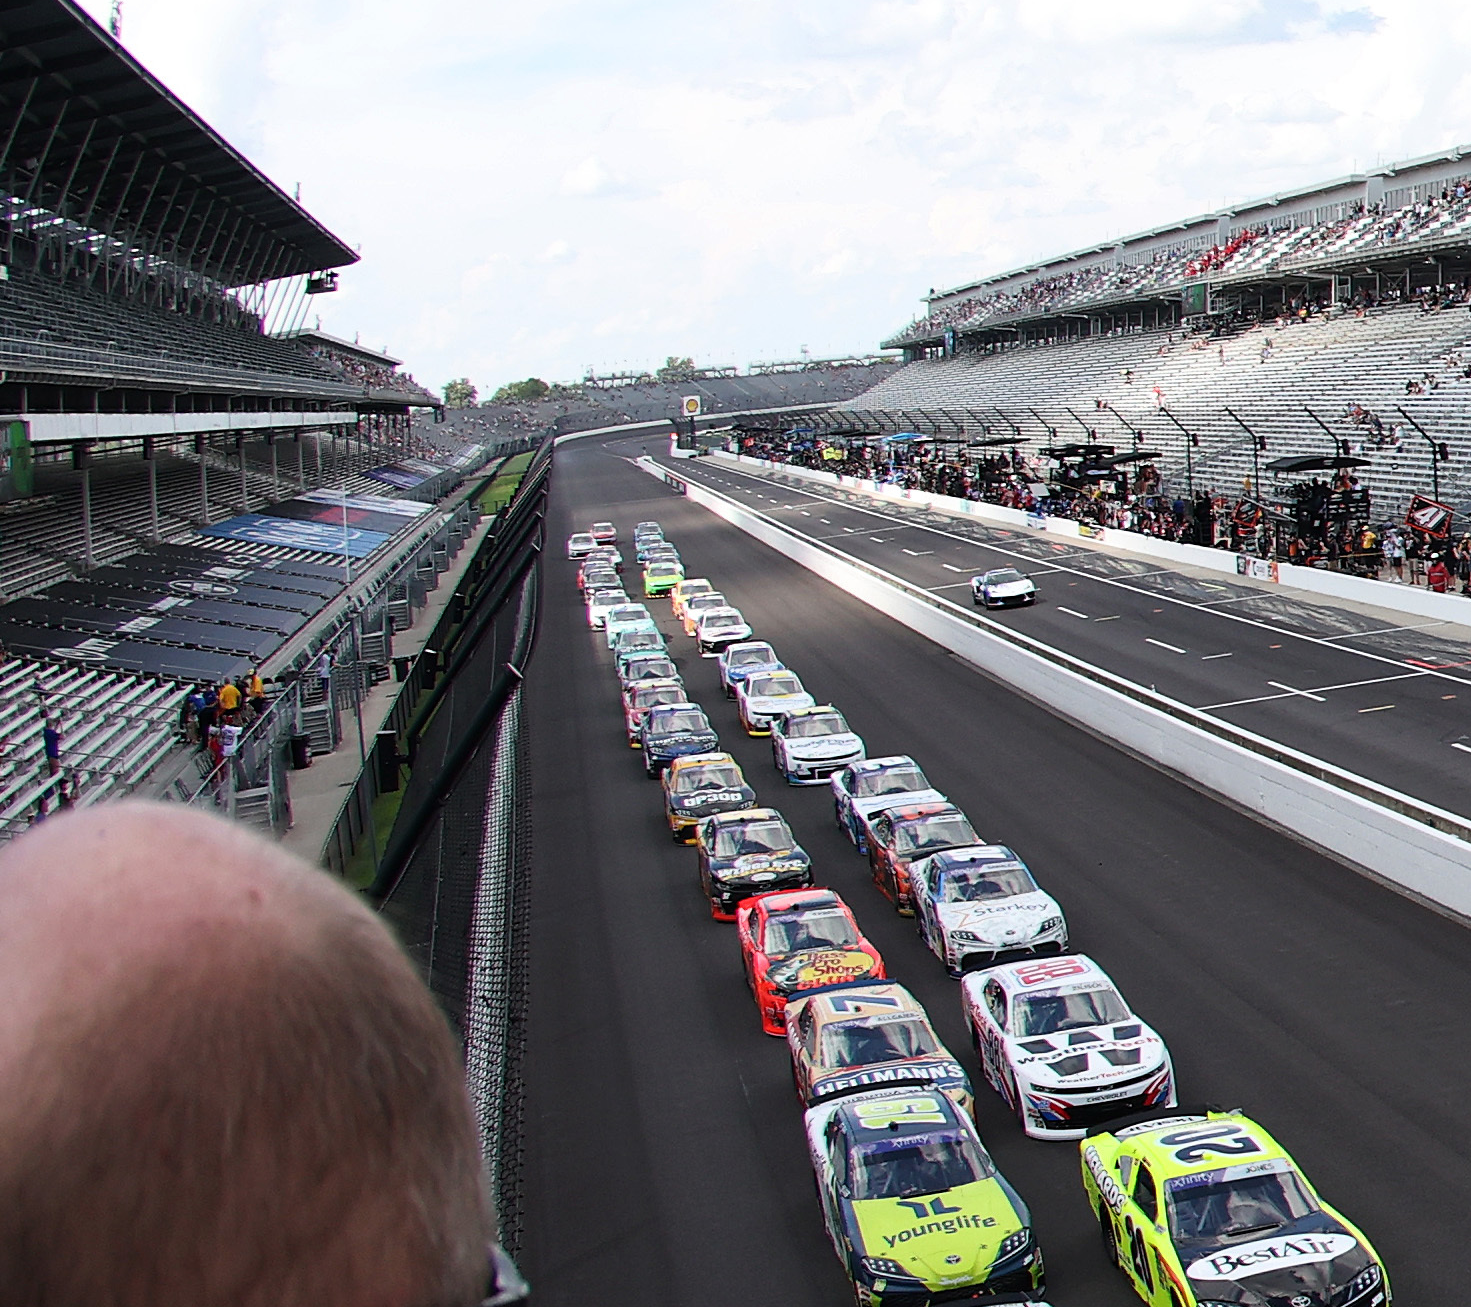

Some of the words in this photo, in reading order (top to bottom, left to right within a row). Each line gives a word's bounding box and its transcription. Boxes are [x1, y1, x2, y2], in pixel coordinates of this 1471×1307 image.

[1413, 507, 1445, 529] 41
[974, 901, 1049, 917] Starkey
[806, 951, 848, 961] Bass
[811, 959, 841, 968] Pro
[813, 964, 864, 977] Shops
[830, 995, 900, 1014] 7
[1016, 1036, 1160, 1065] WeatherTech
[1056, 1064, 1147, 1084] WeatherTech.com
[1086, 1091, 1128, 1104] CHEVROLET
[854, 1098, 946, 1130] 19
[892, 1135, 929, 1147] xfinity
[1159, 1123, 1262, 1164] 20
[1172, 1171, 1215, 1188] xfinity
[1245, 1162, 1275, 1174] JONES
[882, 1214, 996, 1248] younglife
[1210, 1236, 1335, 1276] BestAir
